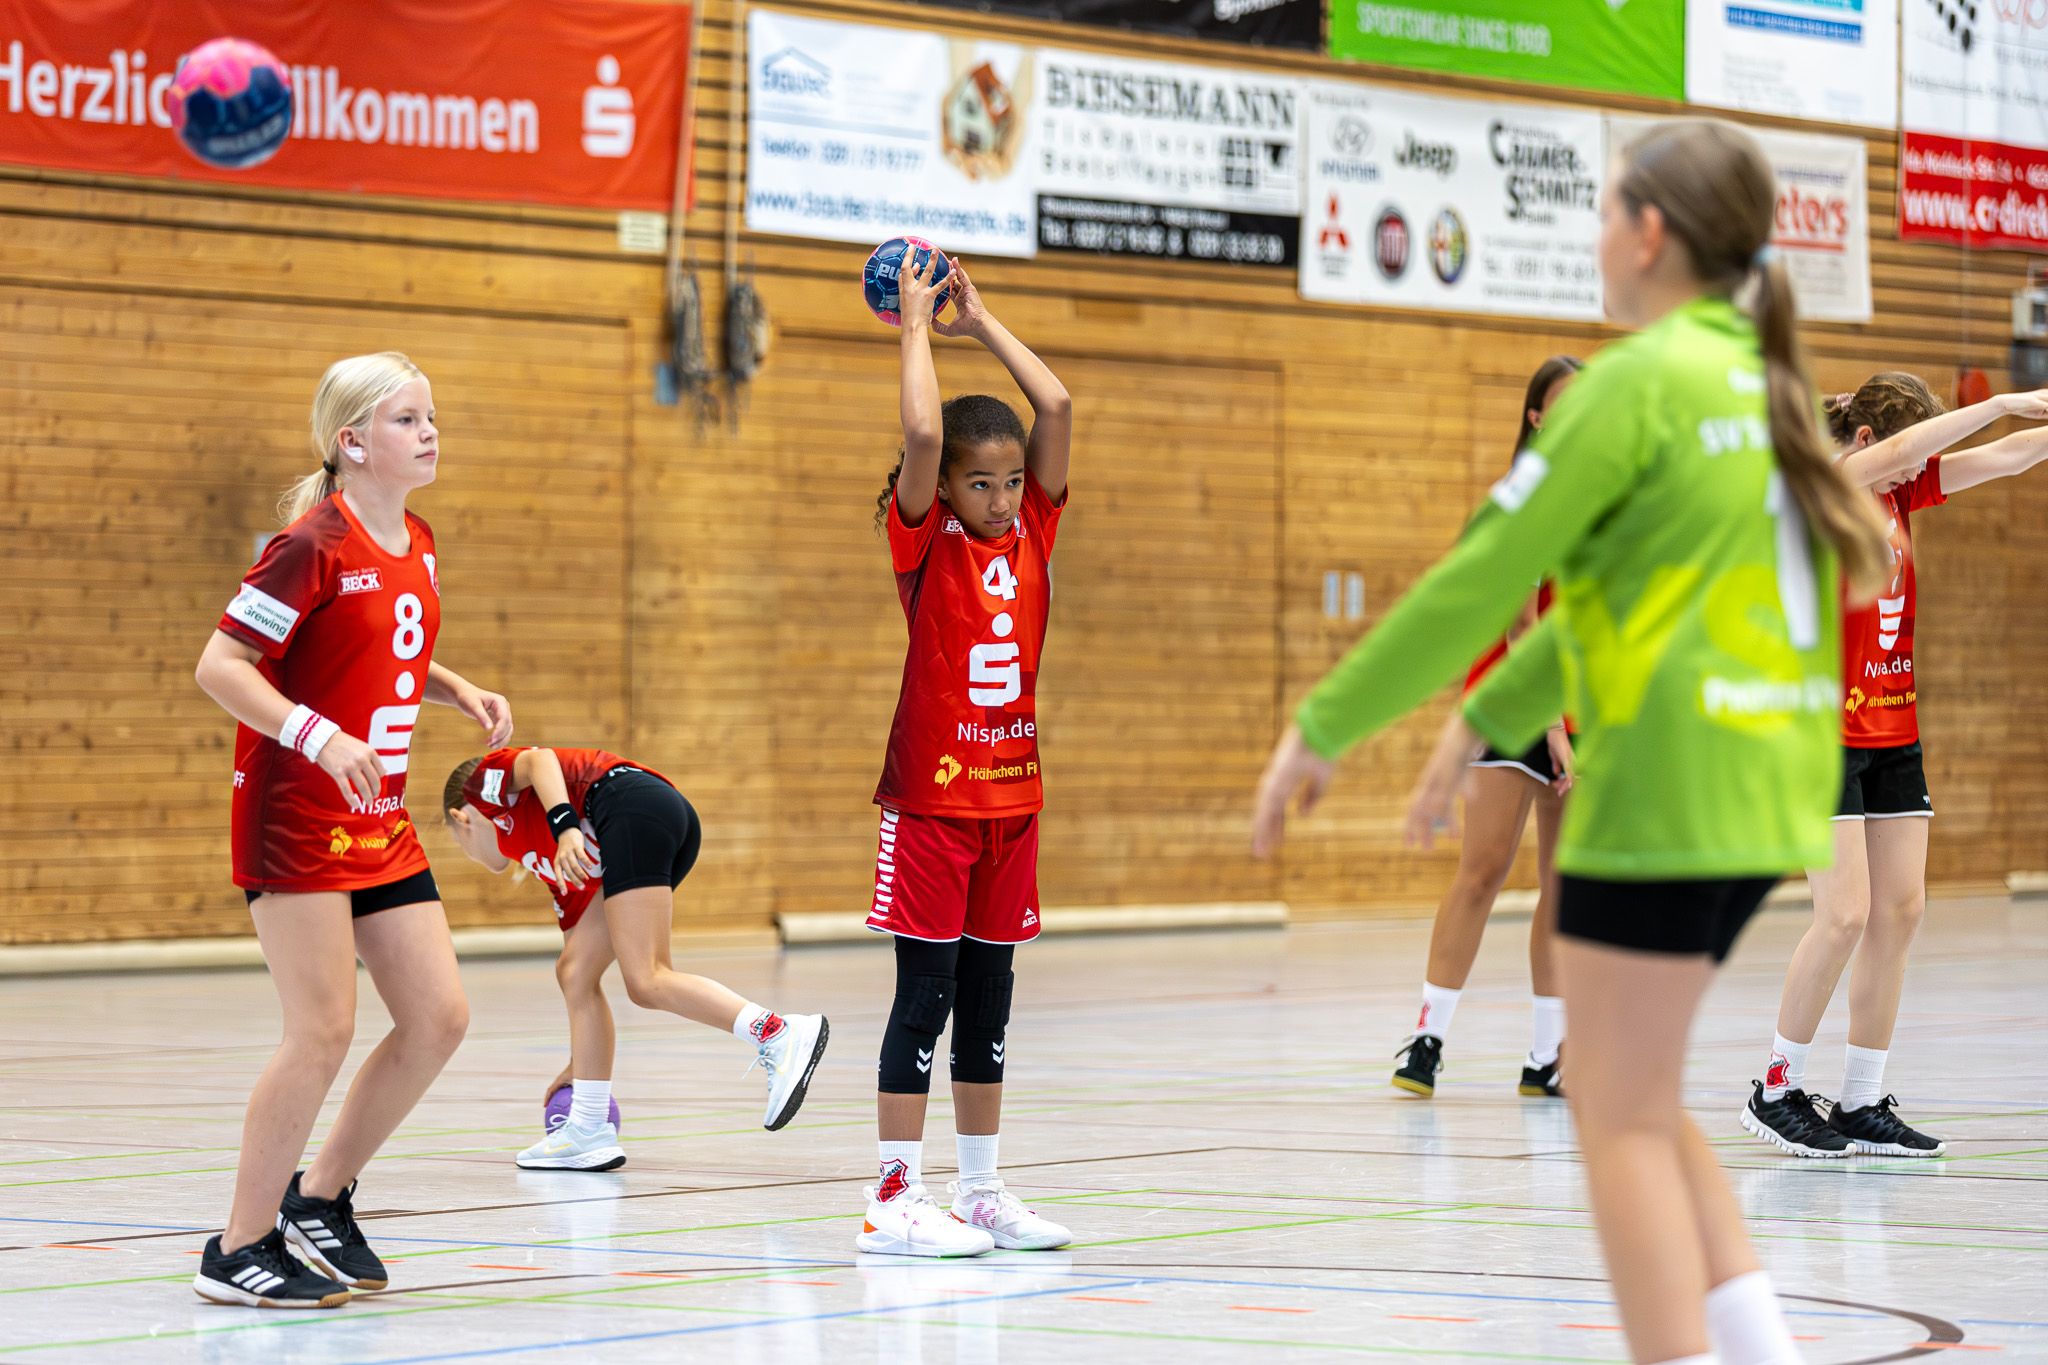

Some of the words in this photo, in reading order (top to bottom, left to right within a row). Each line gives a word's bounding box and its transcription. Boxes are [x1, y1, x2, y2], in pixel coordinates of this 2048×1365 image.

[1048, 65, 1297, 130] BIESEMANN
[1394, 129, 1457, 177] Jeep
[341, 573, 380, 592] BECK
[982, 555, 1019, 601] 4
[244, 605, 287, 637] Grewing
[392, 593, 425, 660] 8
[957, 718, 1036, 747] Nispa.de
[968, 765, 1023, 780] Hähnchen
